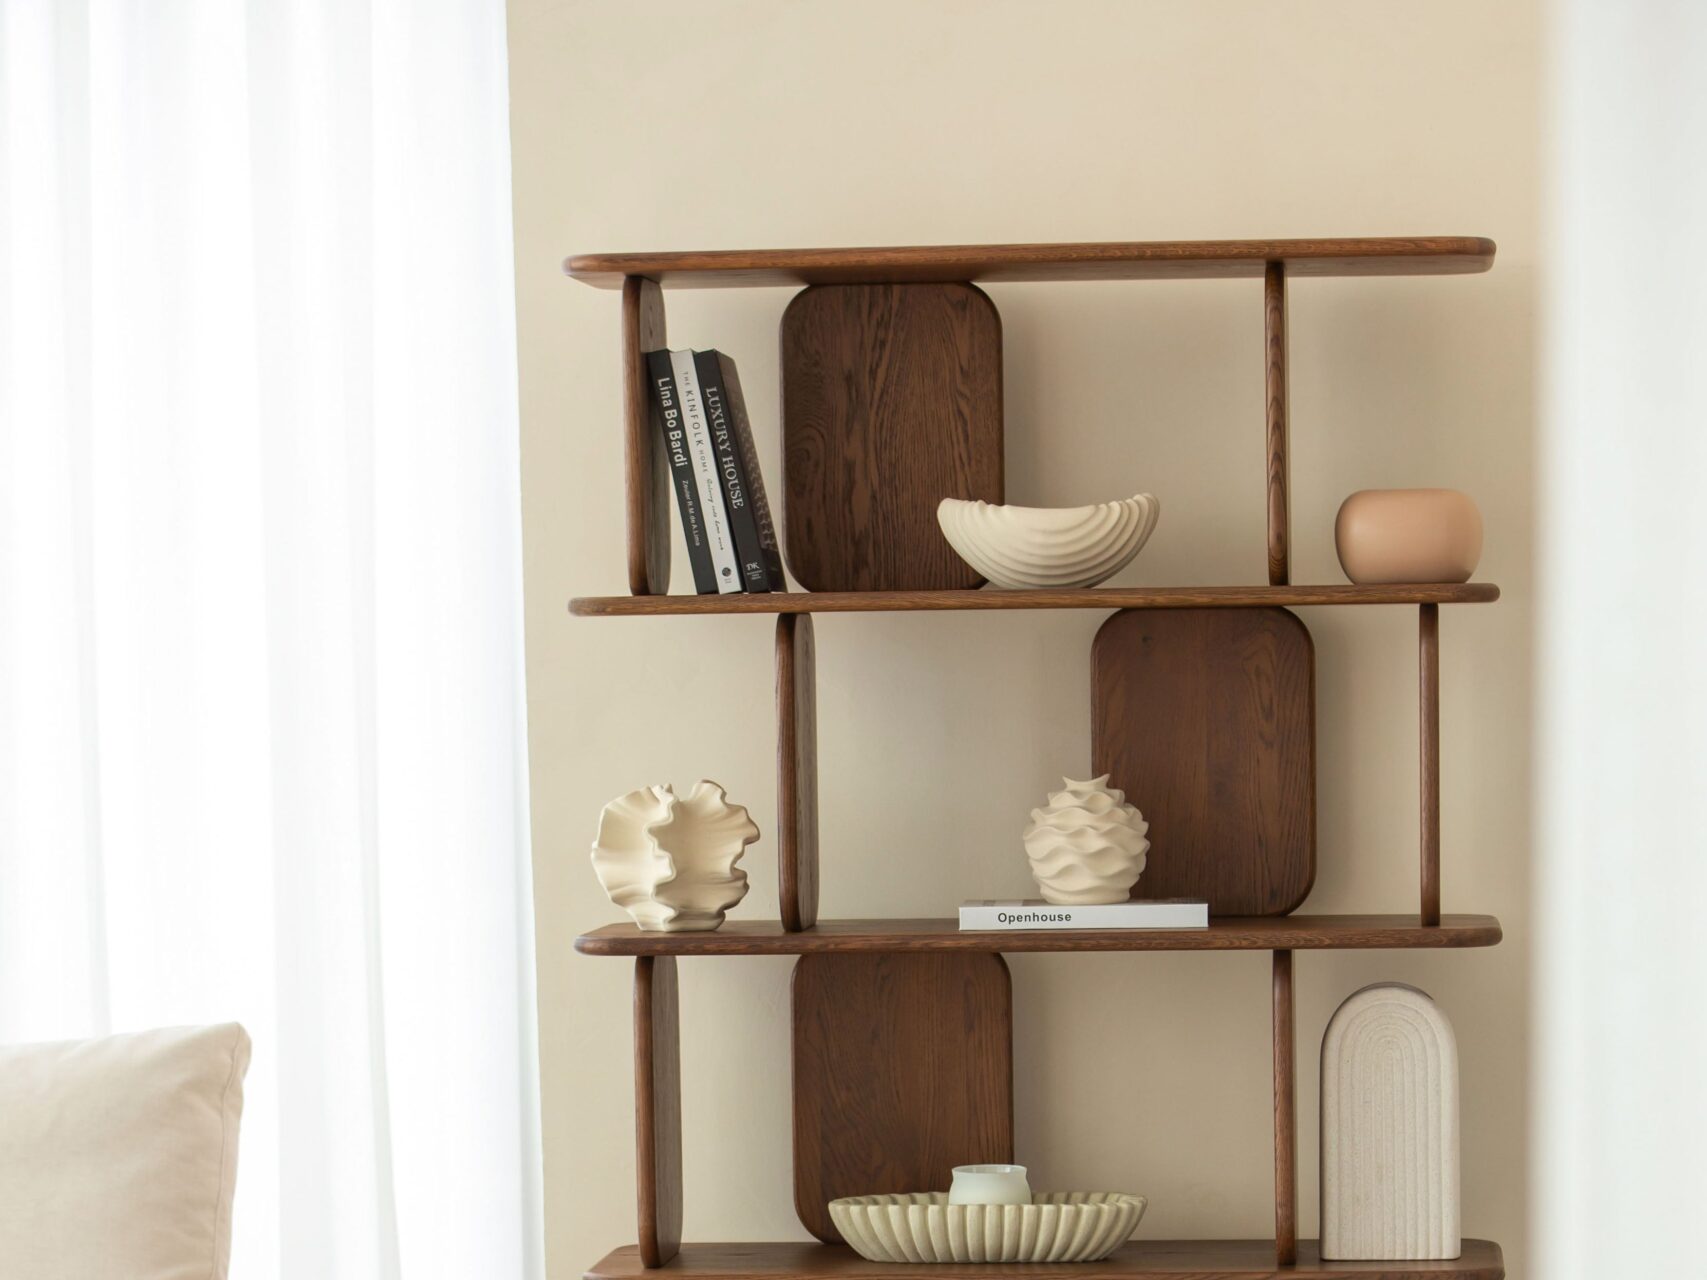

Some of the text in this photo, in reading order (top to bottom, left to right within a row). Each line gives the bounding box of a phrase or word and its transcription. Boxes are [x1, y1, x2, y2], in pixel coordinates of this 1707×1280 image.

[658, 378, 688, 467] Lina Bo Bardi
[682, 371, 708, 473] THE KINFOLK HOME
[705, 386, 732, 451] LUXURY
[722, 455, 744, 509] HOUSE
[746, 562, 760, 571] DK
[997, 912, 1072, 925] Openhouse
